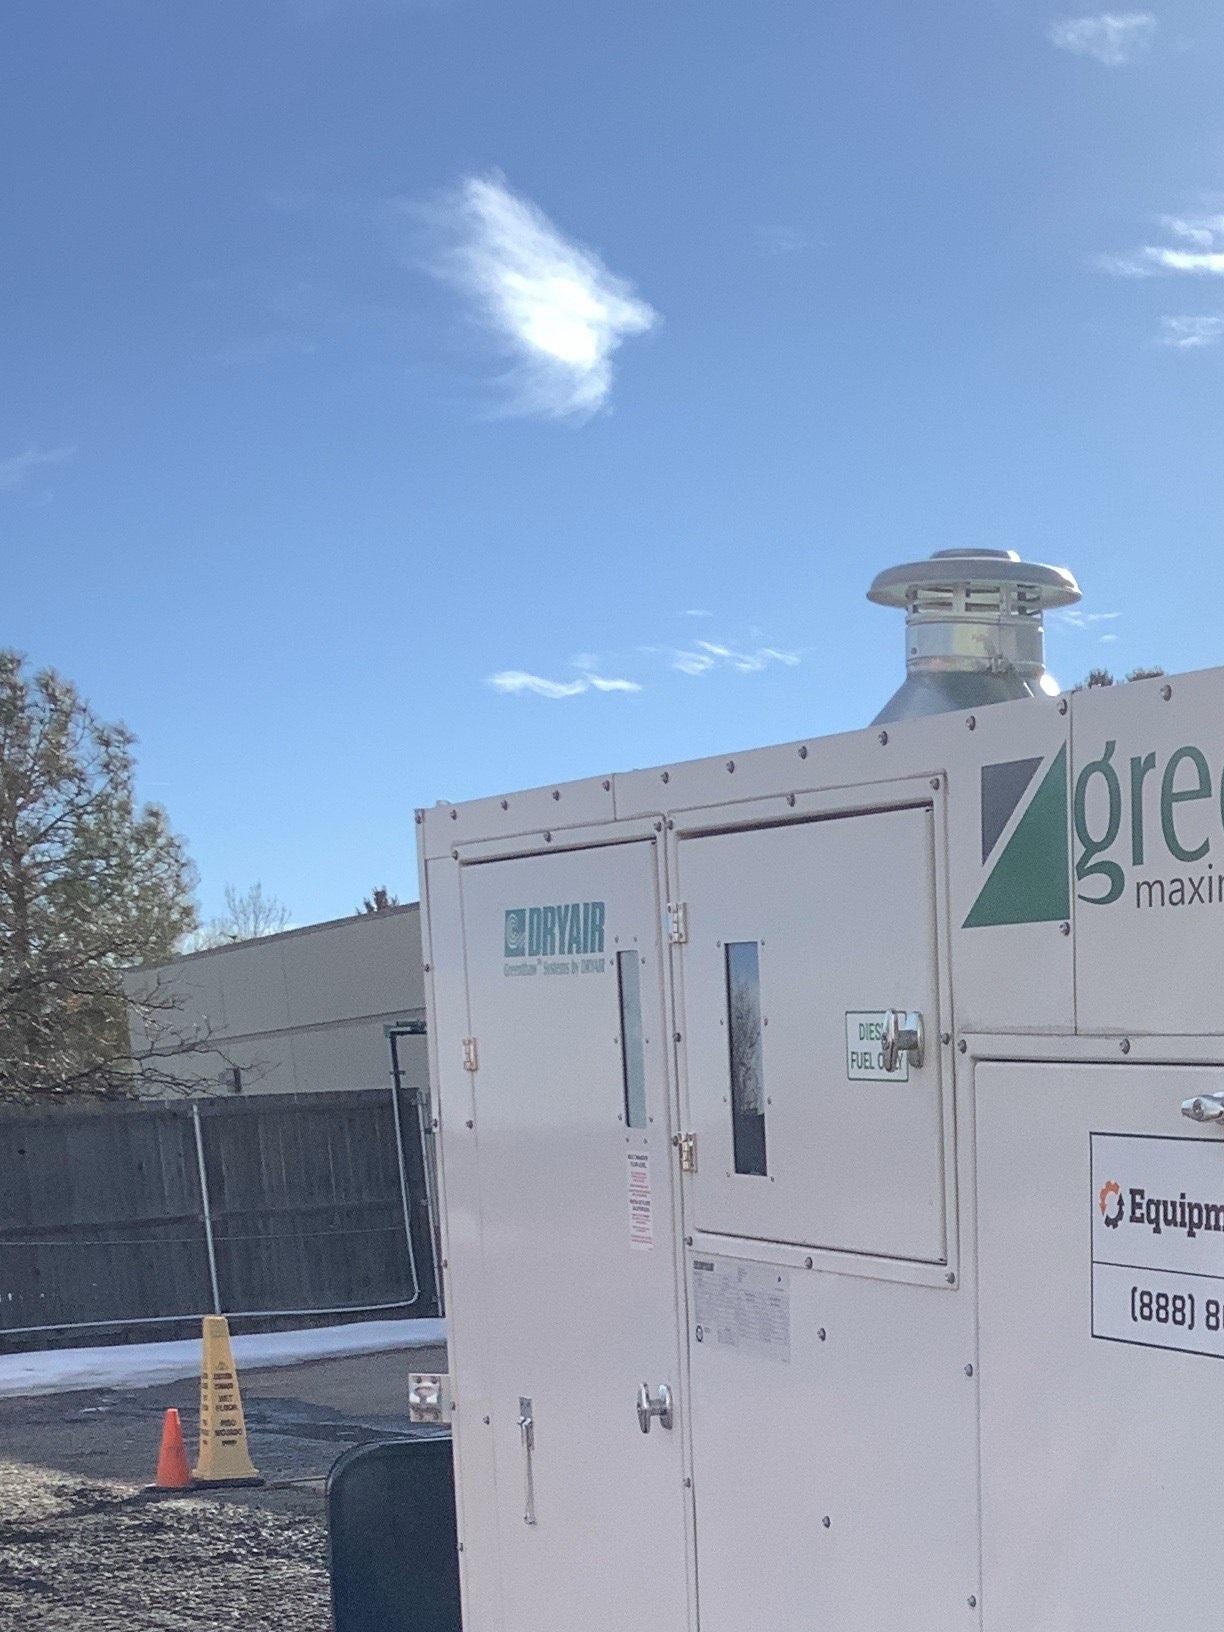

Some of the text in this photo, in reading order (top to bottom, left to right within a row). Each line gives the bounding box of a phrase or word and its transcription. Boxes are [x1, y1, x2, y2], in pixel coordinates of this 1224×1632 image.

[526, 901, 605, 957] DRYAIR
[858, 1023, 884, 1041] DIES
[851, 1051, 875, 1070] FUEL
[1131, 1286, 1196, 1331] (888)
